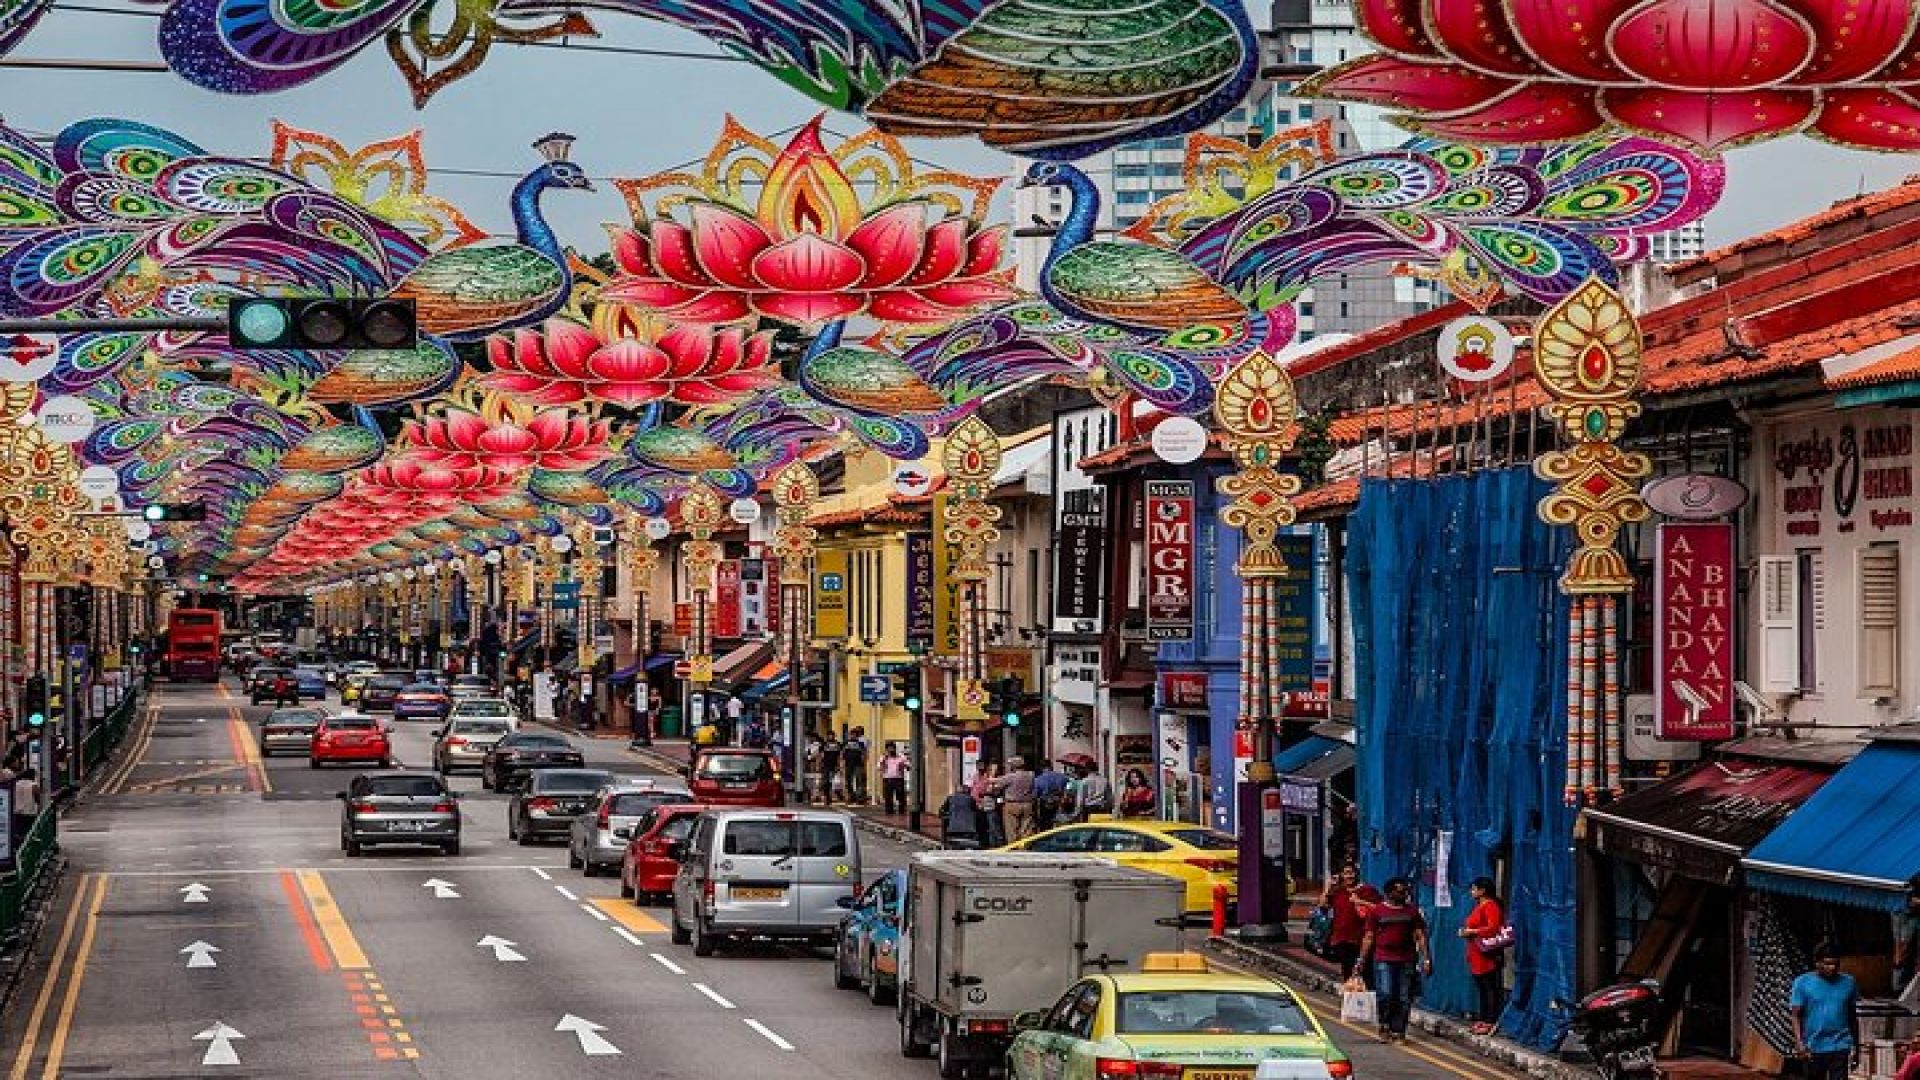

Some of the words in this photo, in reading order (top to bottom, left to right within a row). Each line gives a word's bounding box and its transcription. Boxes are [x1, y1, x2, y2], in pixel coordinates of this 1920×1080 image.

[1074, 529, 1089, 614] JEWELLERS
[1151, 522, 1190, 596] MGR
[1669, 534, 1694, 673] ANANDA
[1700, 565, 1726, 703] BHAVAN
